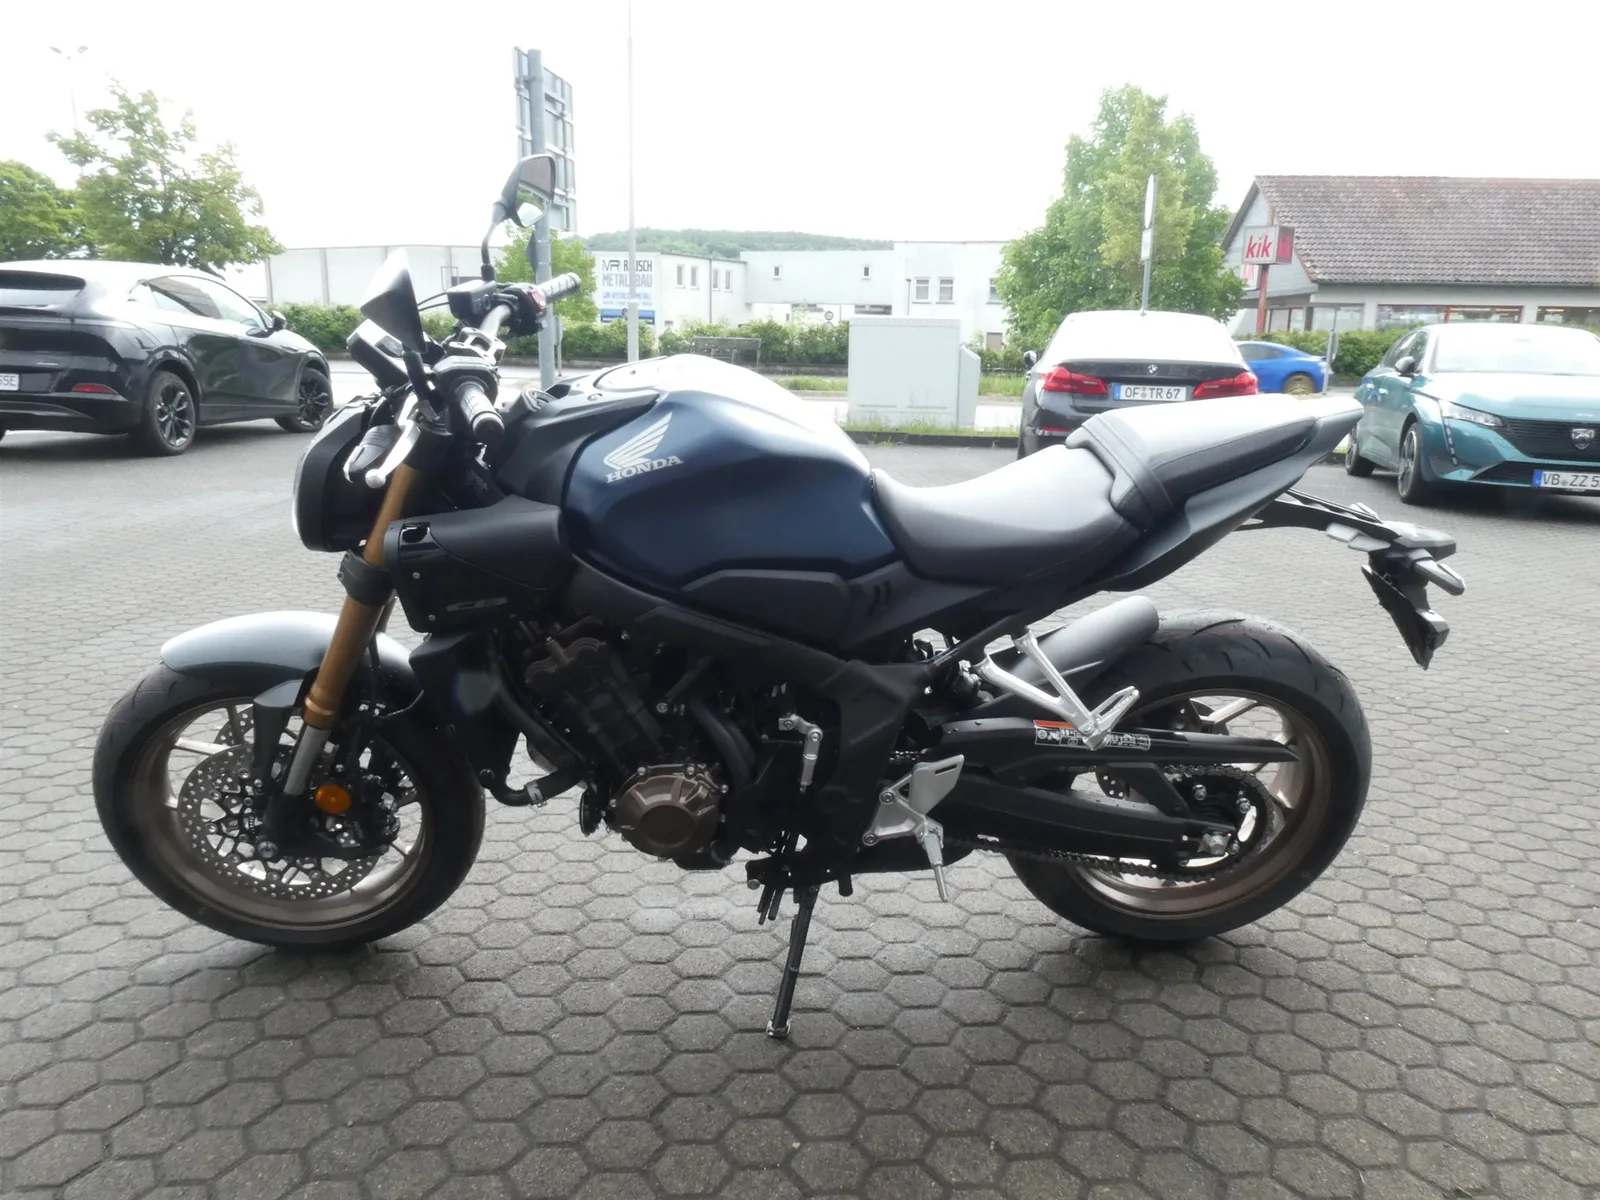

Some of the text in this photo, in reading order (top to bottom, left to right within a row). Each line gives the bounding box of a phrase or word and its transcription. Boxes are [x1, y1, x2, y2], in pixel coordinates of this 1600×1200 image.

[1246, 234, 1272, 258] kik
[602, 273, 652, 287] METALBAU
[1125, 387, 1180, 399] OF TR 67
[605, 455, 684, 484] HONDA
[1543, 473, 1560, 486] VB
[1569, 474, 1588, 487] ZZ
